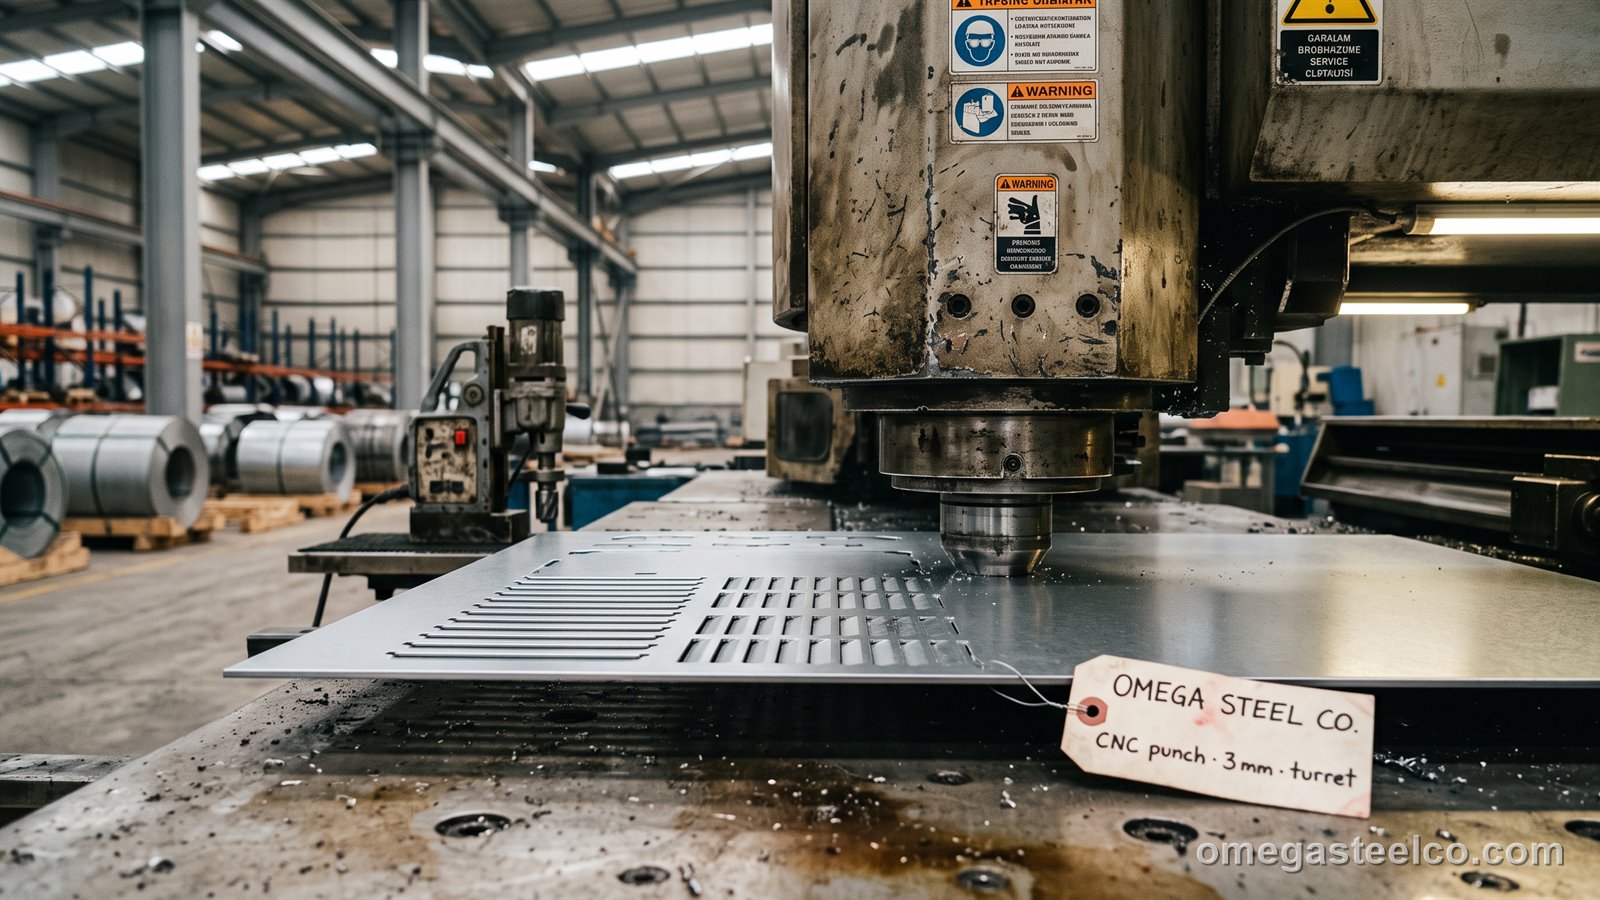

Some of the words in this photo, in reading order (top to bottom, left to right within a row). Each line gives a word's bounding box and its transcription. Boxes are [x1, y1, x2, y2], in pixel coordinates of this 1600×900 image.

[1307, 34, 1351, 43] GARALAM
[1310, 57, 1349, 66] SERVICE
[1026, 85, 1093, 96] WARNING
[1011, 179, 1054, 189] WARNING
[1113, 674, 1204, 709] OMEGA
[1220, 694, 1303, 726] STEEL
[1316, 709, 1358, 733] CO.
[1095, 732, 1138, 753] CNC
[1149, 744, 1205, 764] punch
[1289, 761, 1357, 788] turret
